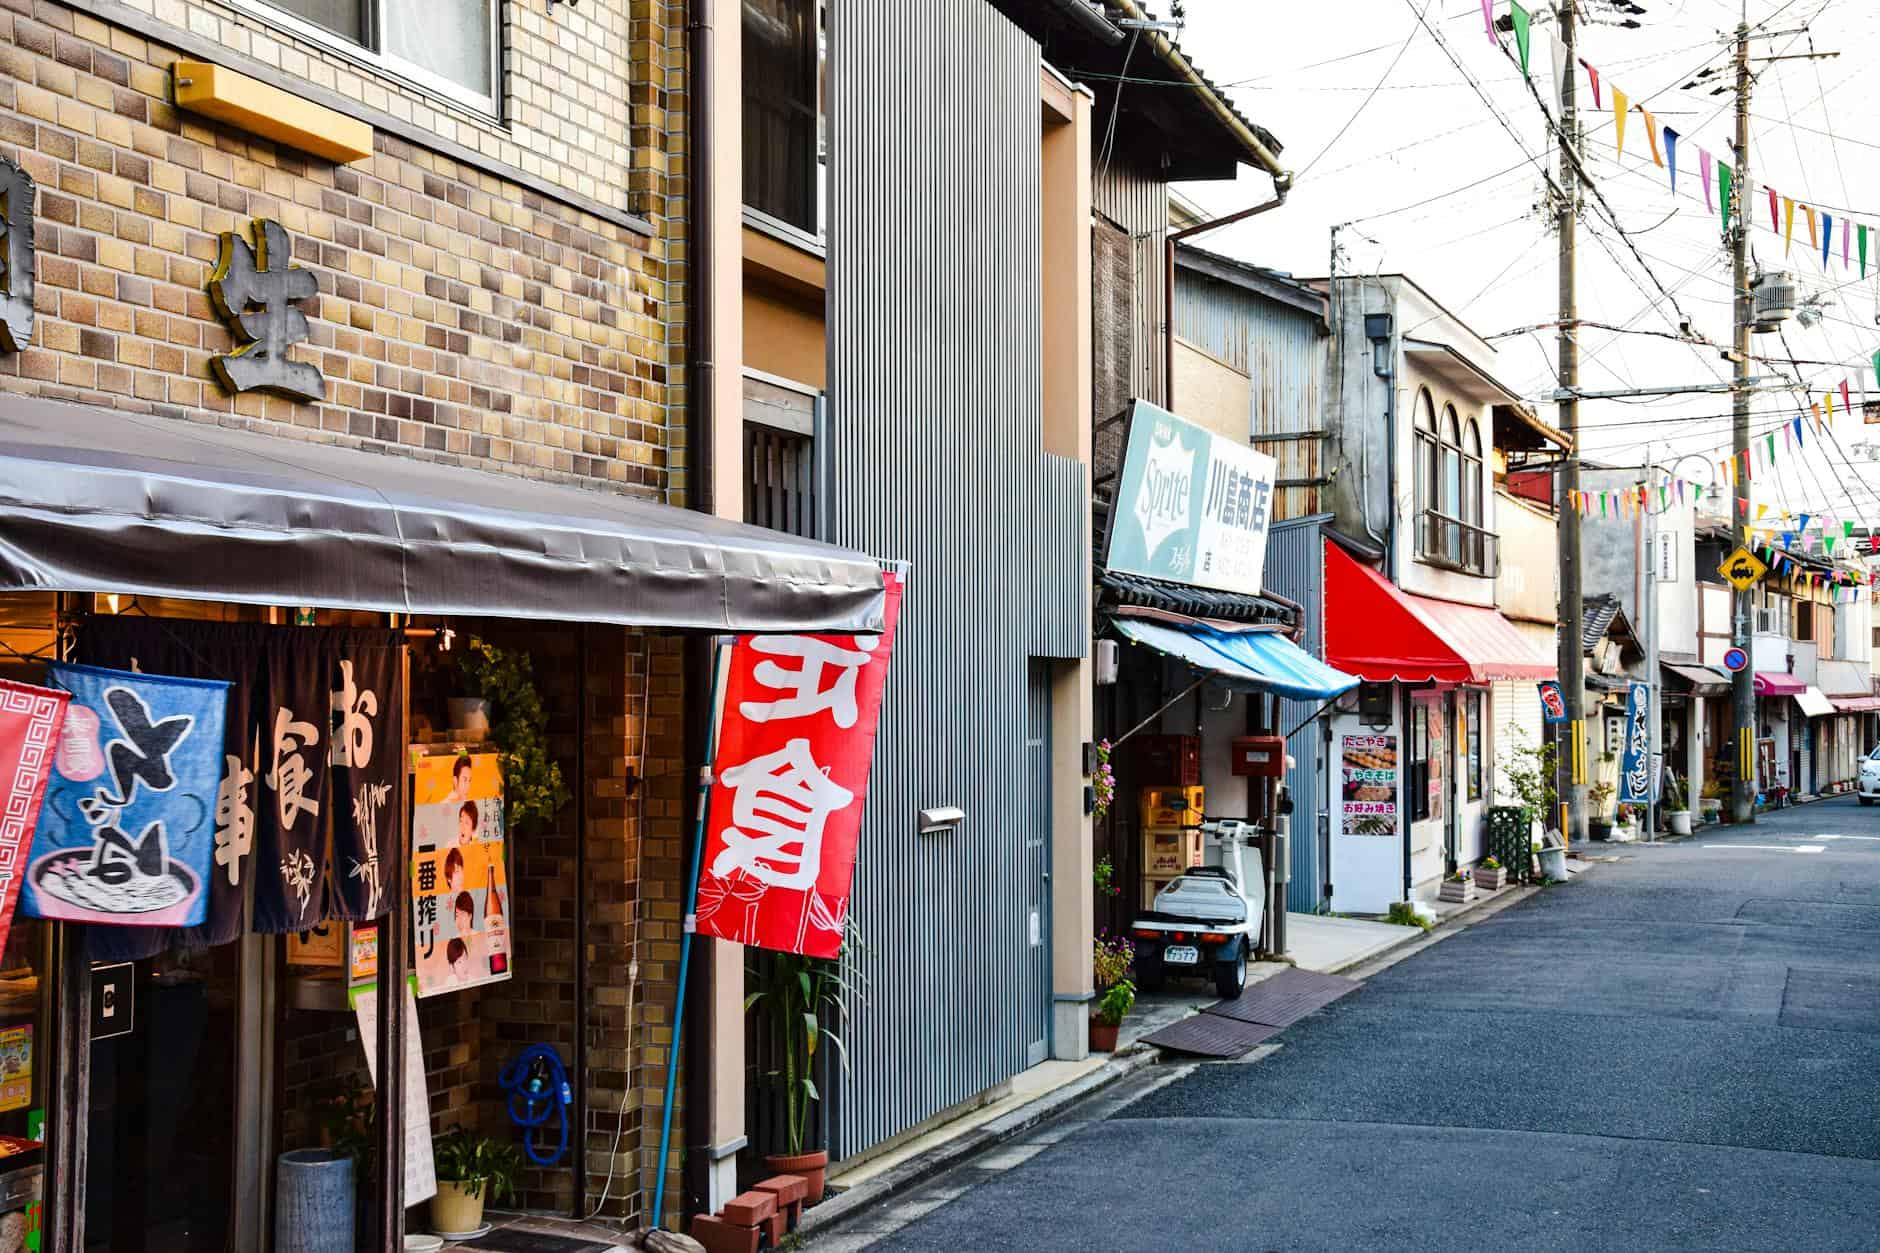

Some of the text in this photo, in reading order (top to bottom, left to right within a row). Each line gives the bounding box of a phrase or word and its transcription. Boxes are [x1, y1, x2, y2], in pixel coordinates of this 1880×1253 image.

[1140, 457, 1189, 531] Sprite
[1344, 735, 1386, 747] たこやき
[1343, 802, 1395, 815] お好み焼き
[417, 843, 437, 960] 一番搾り
